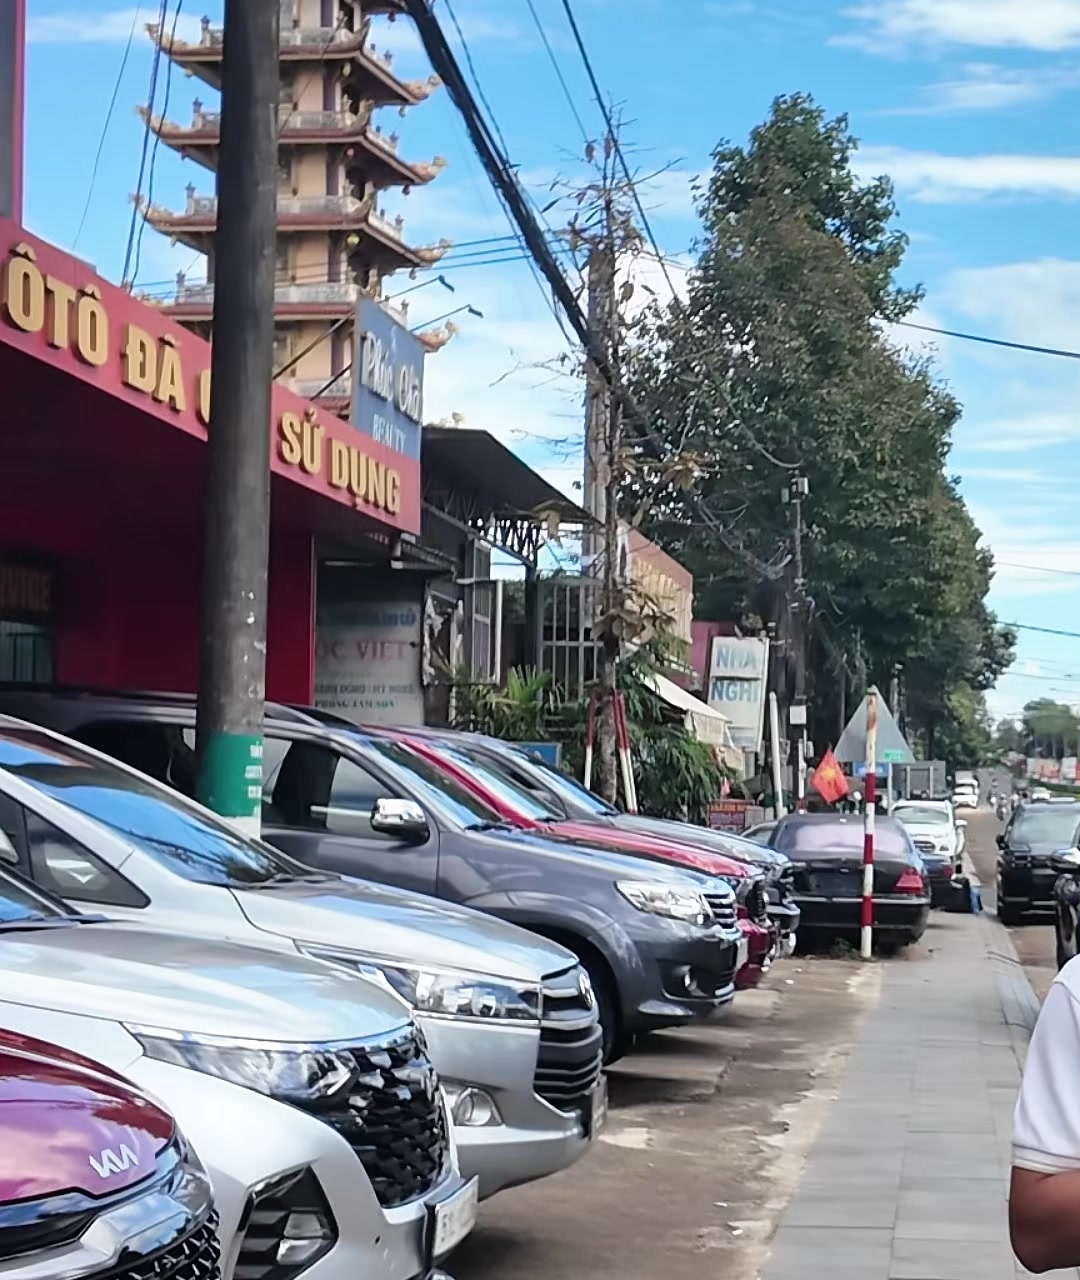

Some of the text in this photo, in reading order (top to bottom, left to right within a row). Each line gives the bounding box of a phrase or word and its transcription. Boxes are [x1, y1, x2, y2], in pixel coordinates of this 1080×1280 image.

[7, 241, 109, 367] ÔTÔ
[279, 407, 325, 475] SỬ
[330, 438, 401, 516] DỤNG
